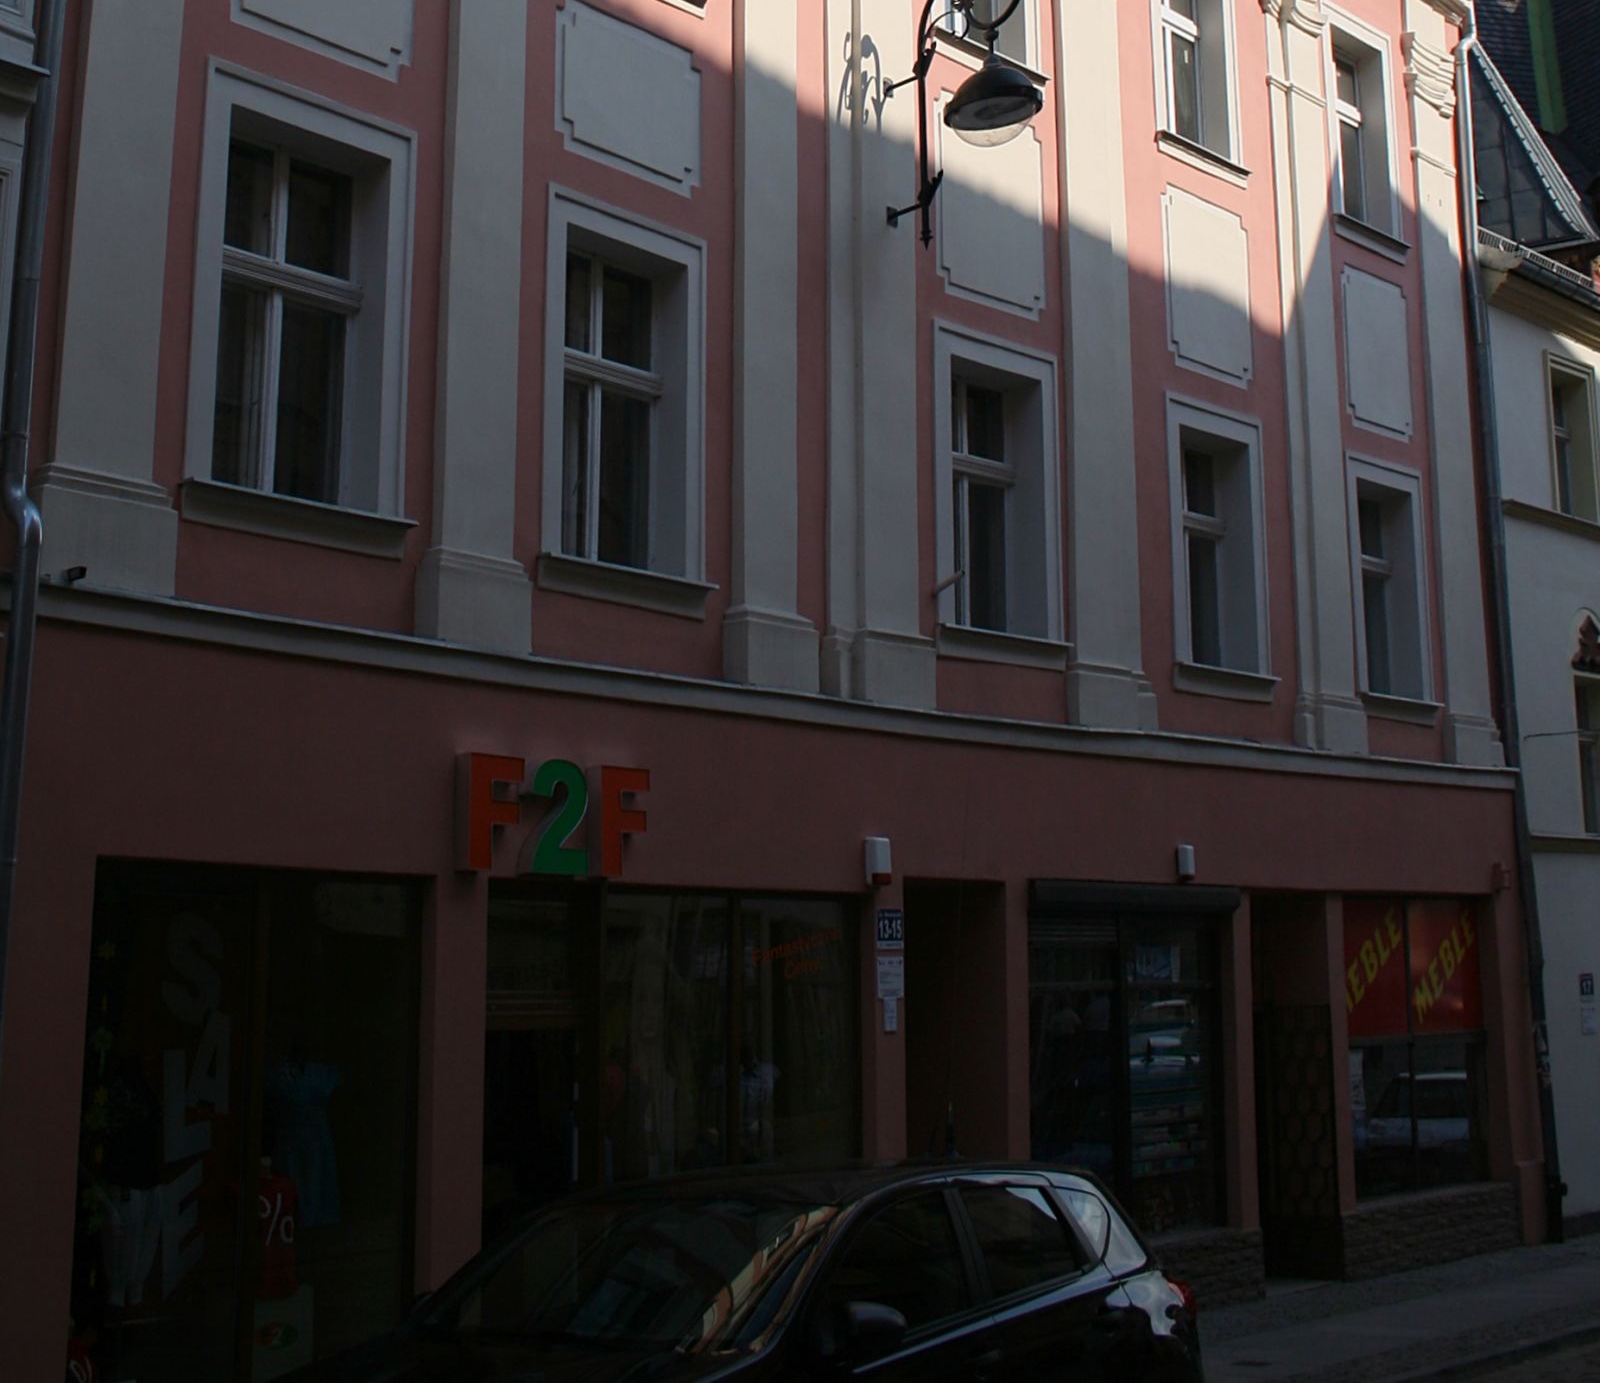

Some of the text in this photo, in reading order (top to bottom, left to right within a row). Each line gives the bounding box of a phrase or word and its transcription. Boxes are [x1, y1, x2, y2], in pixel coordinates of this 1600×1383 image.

[467, 752, 650, 876] F2F
[879, 919, 902, 939] 13-15
[1413, 906, 1476, 1025] MEBLE
